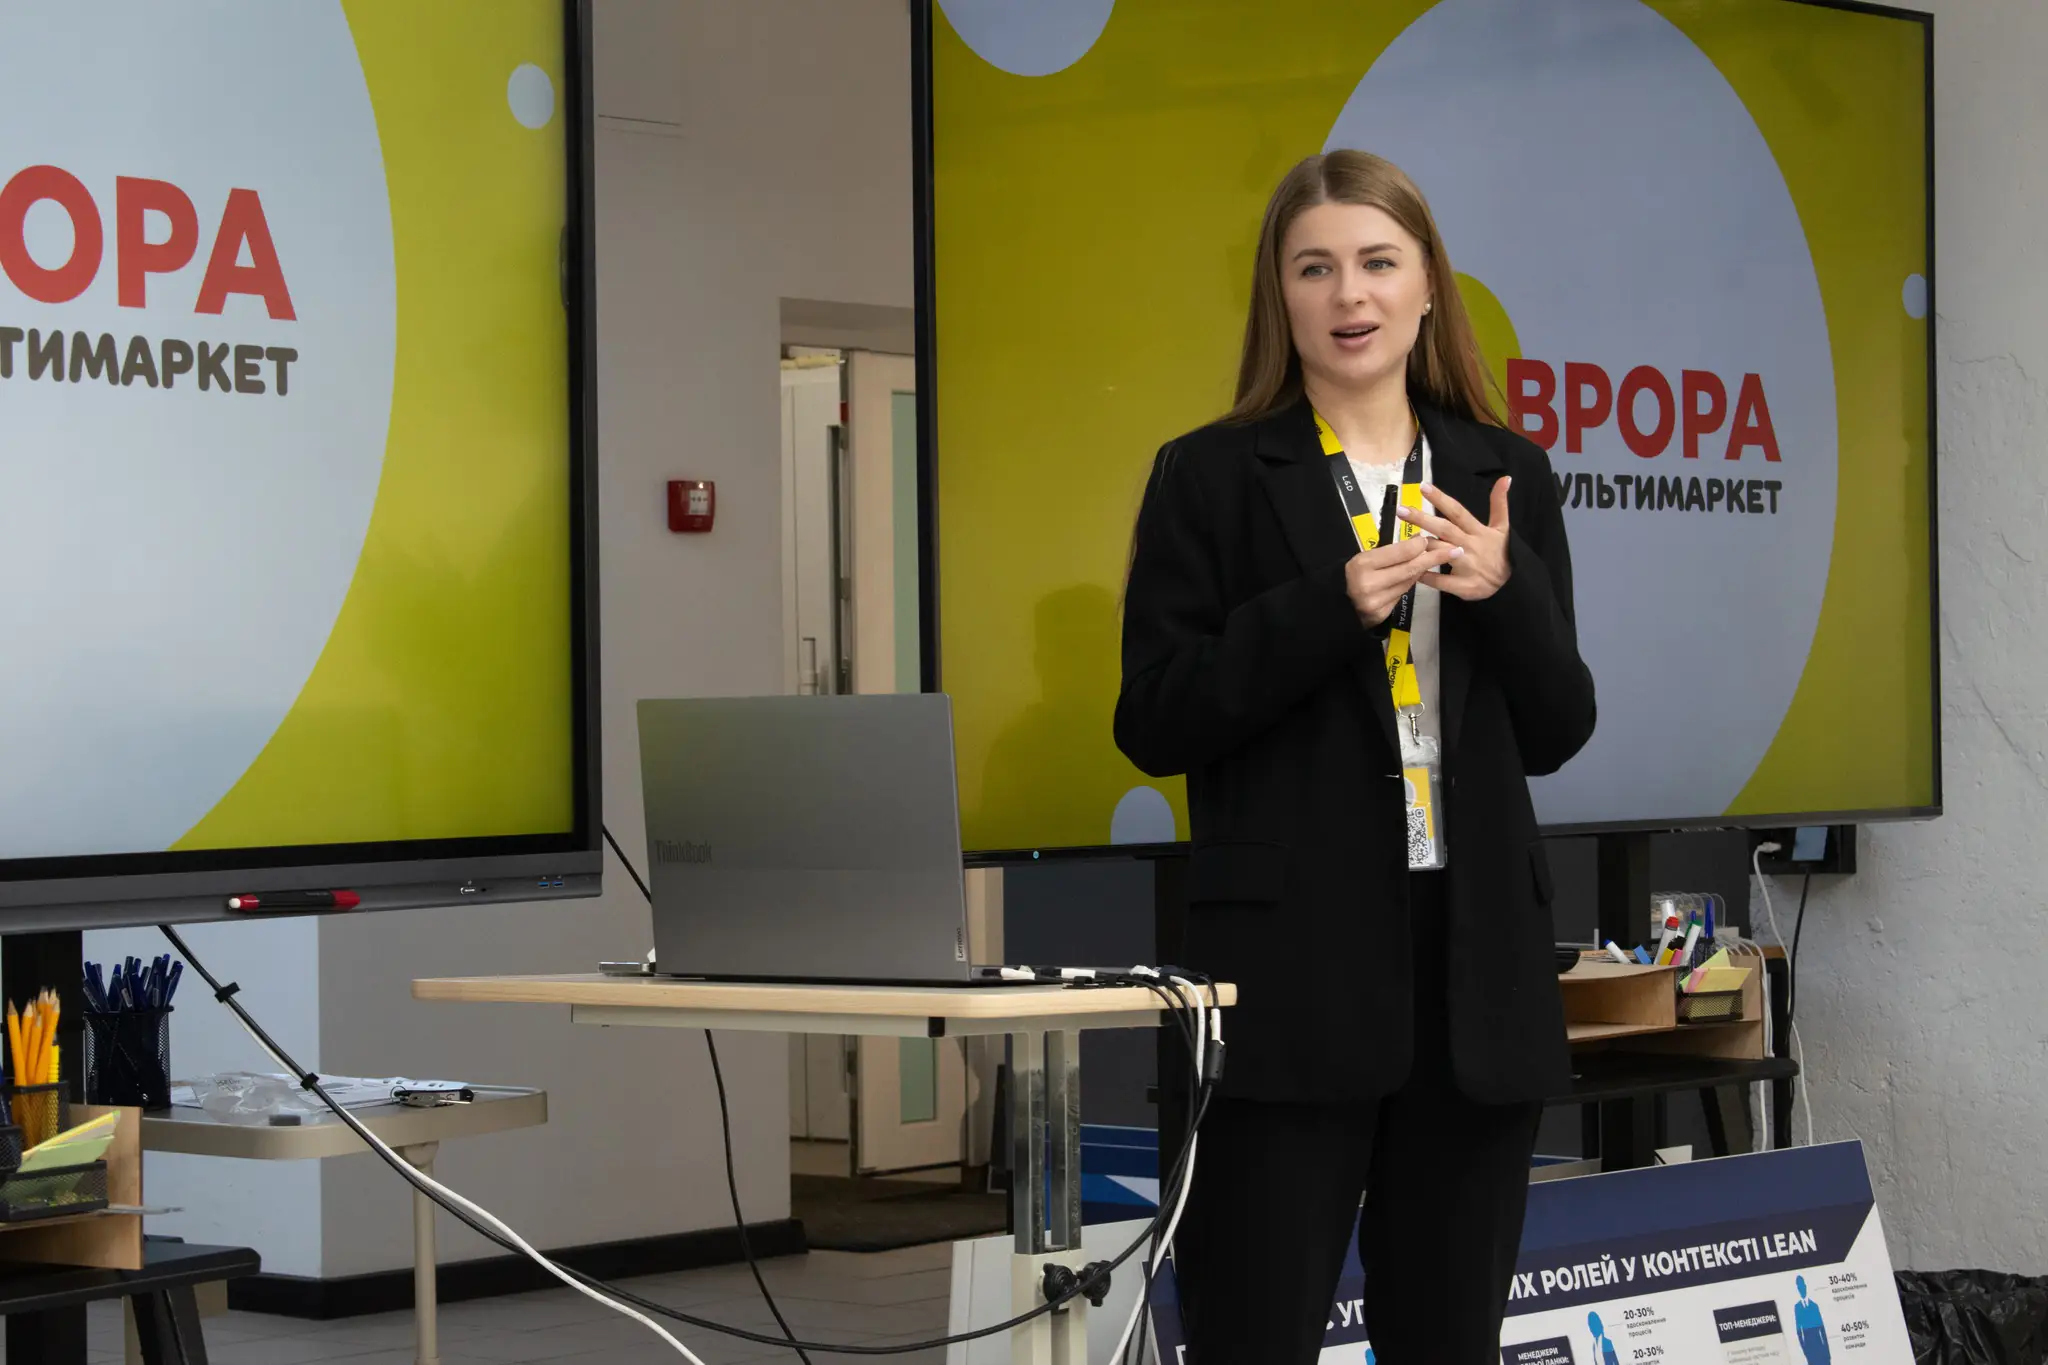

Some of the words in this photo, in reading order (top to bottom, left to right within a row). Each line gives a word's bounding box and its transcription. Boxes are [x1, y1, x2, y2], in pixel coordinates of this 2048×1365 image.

[0, 165, 297, 321] ОРА
[0, 326, 298, 396] ТИМАРКЕТ
[1399, 594, 1409, 627] CAPITAL
[1540, 1253, 1620, 1295] РОЛЕЙ
[1620, 1256, 1636, 1282] У
[1642, 1237, 1761, 1279] КОНТЕКСТІ
[1762, 1228, 1818, 1260] LEAN
[1828, 1272, 1857, 1285] 30-40%
[1624, 1306, 1655, 1320] 20-30%
[1719, 1314, 1777, 1331] ТОП-МЕНЕДЖЕРИ:
[1841, 1320, 1870, 1333] 40-50%
[1517, 1347, 1559, 1361] МЕНЕДЖЕРИ
[1633, 1345, 1665, 1359] 20-30%
